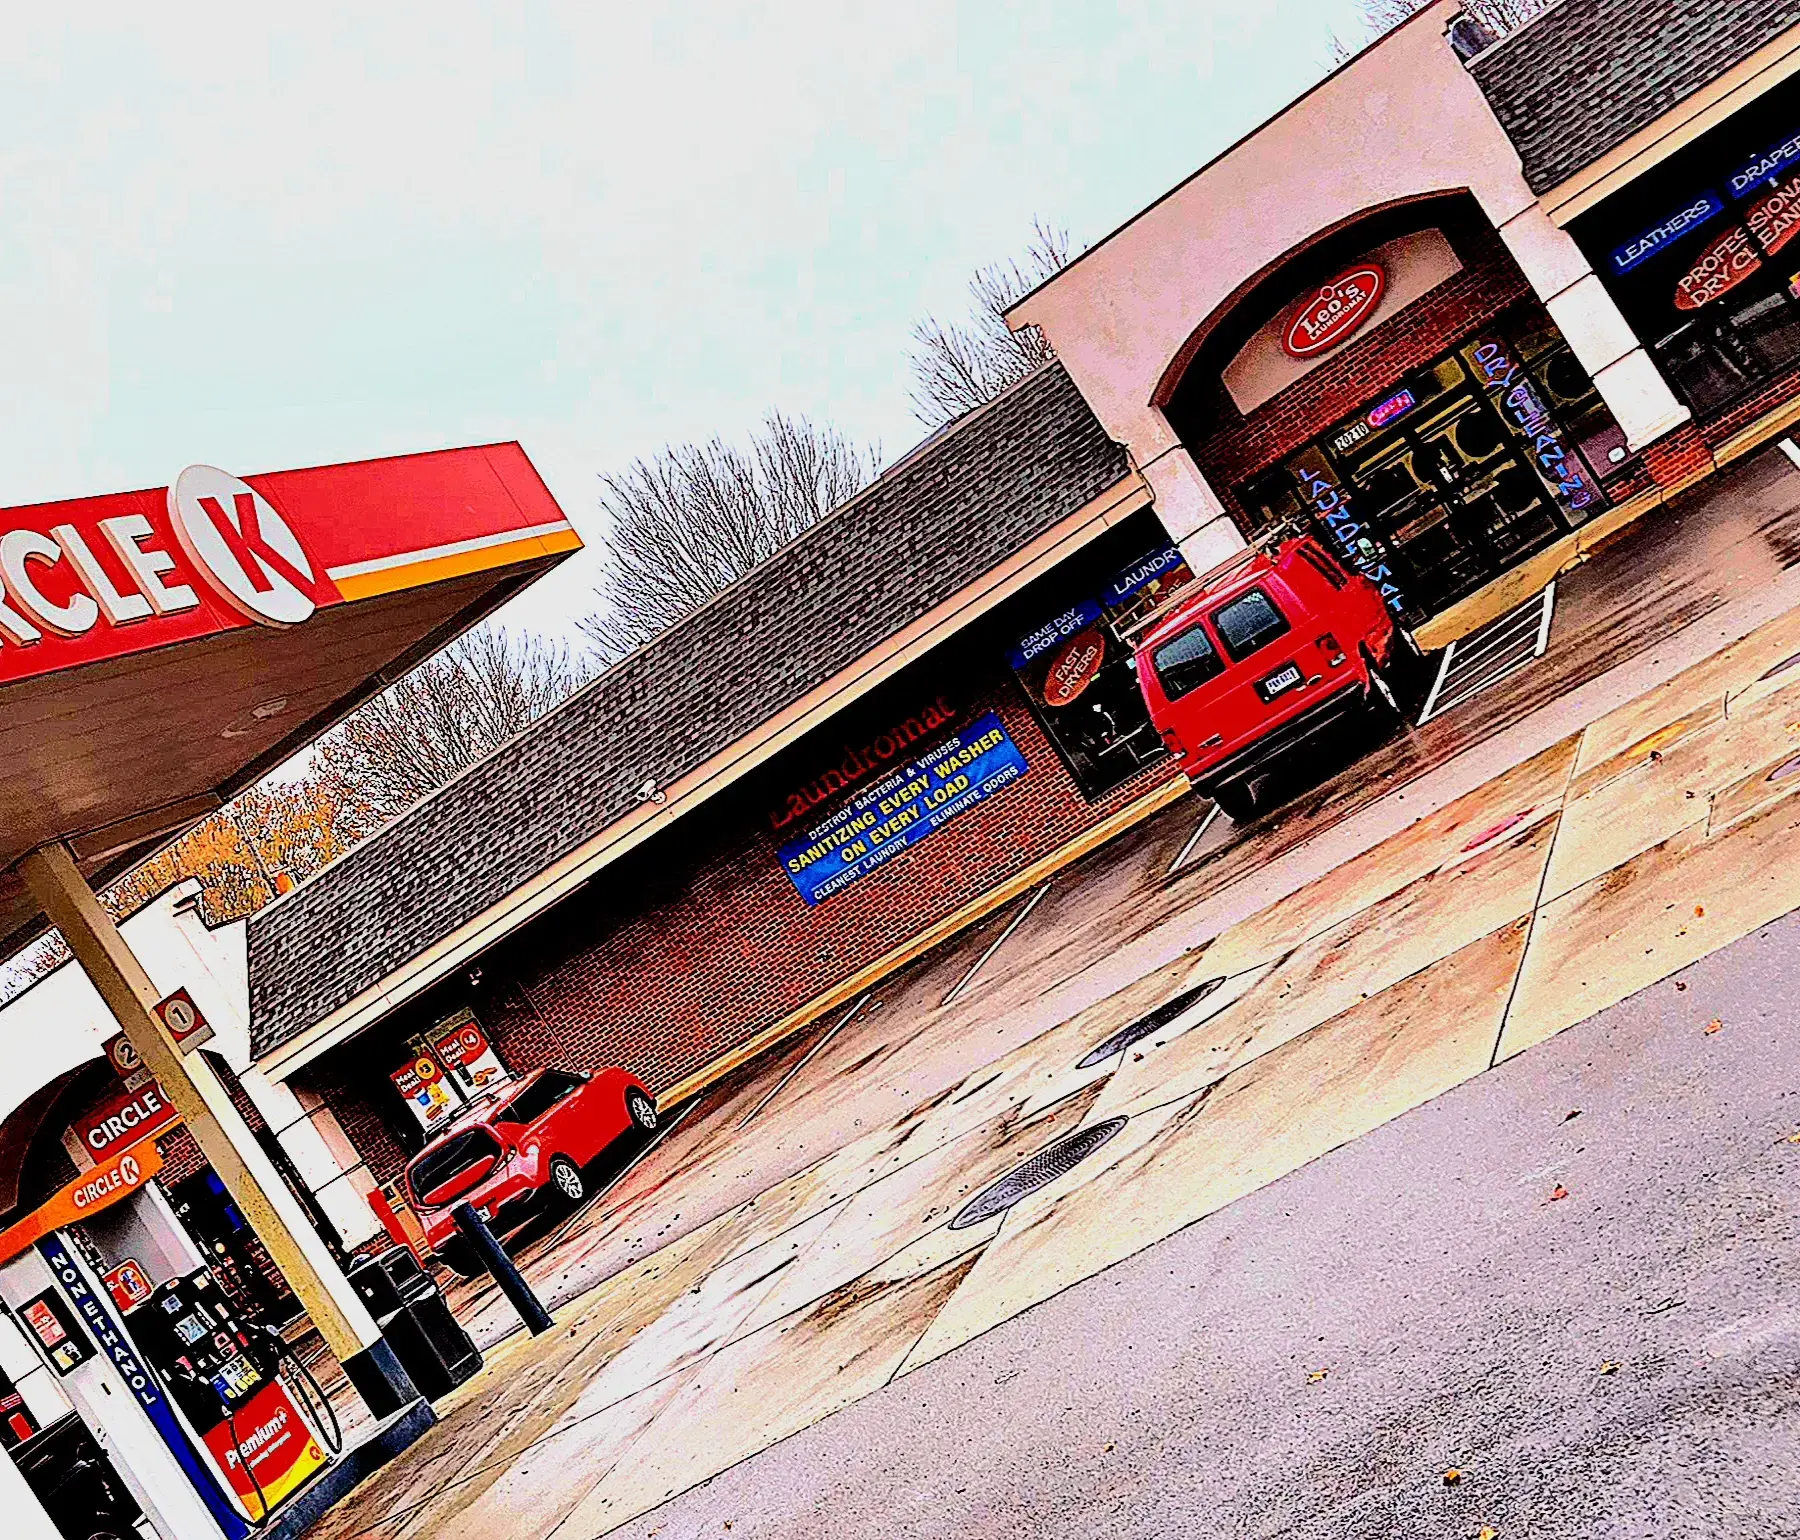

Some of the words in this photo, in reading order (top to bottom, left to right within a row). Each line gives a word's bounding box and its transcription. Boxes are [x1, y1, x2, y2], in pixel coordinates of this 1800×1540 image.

[1614, 199, 1711, 267] LEATHERS
[1690, 264, 1731, 307] DRY
[1309, 290, 1367, 340] LAUNDROMAT
[1334, 421, 1370, 451] 20210
[1474, 343, 1520, 388] DRY
[1507, 388, 1592, 510] CLEANING
[192, 488, 315, 602] K
[1299, 469, 1404, 611] LAUNDRMAT
[1021, 623, 1055, 649] SAME
[1053, 608, 1076, 627] DAY
[1023, 632, 1058, 659] DROP
[1060, 613, 1084, 635] OFF
[1055, 647, 1080, 681] FAST
[1058, 645, 1098, 697] DRYERS
[768, 696, 956, 829] Laundromat
[808, 806, 853, 841] DESTROY
[855, 775, 904, 811] BACTERIA
[906, 767, 916, 778] &
[917, 737, 961, 769] VIRUSES
[788, 814, 877, 874] SANITIZING
[879, 775, 931, 816] EVERY
[934, 728, 1005, 779] WASHER
[841, 840, 867, 863] ON
[869, 804, 920, 846] EVERY
[927, 774, 970, 810] LOAD
[814, 867, 862, 900] CLEANEST
[862, 836, 909, 875] LAUNDRY
[930, 791, 982, 827] ELIMINATE
[982, 765, 1019, 793] ODORS
[172, 1006, 188, 1025] 1
[119, 1043, 136, 1066] 2
[88, 1091, 162, 1149] CIRCLE
[73, 1168, 123, 1208] CIRCLE
[123, 1158, 138, 1183] K
[51, 1253, 88, 1299] NON
[84, 1300, 157, 1405] ETHANOL
